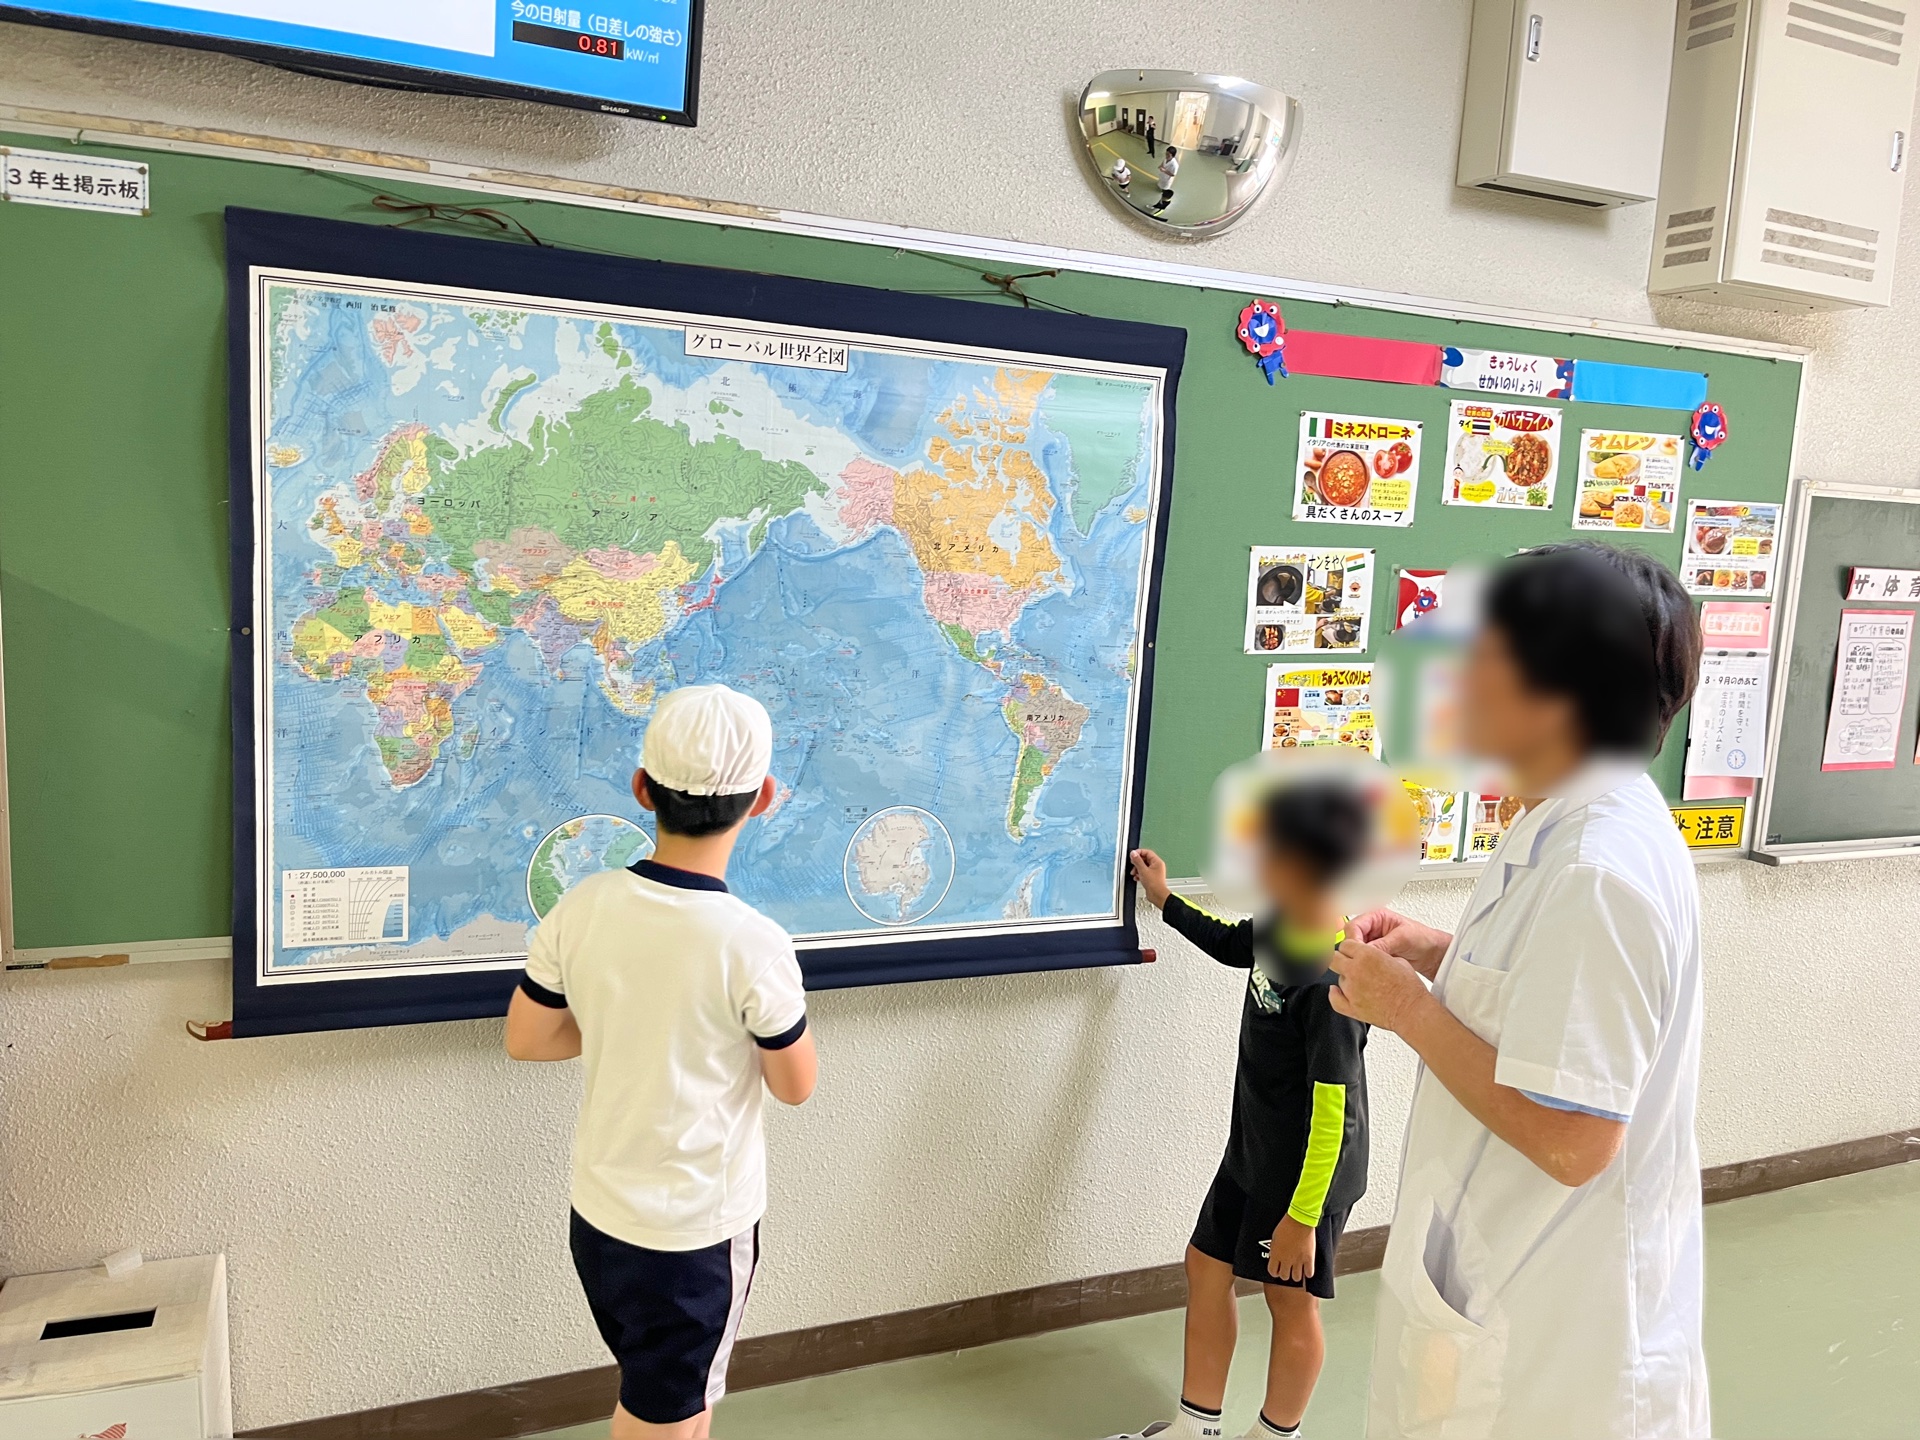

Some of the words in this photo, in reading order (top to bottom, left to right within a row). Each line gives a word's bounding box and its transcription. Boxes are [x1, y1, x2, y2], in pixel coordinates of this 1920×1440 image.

[578, 35, 618, 56] 0.81
[601, 105, 629, 114] SHARP
[8, 168, 140, 200] 3年生掲示板
[346, 301, 362, 309] 西川
[691, 333, 845, 366] グローバル世界全図
[1489, 355, 1538, 373] きゅうしょく
[1478, 374, 1542, 394] せかいのりょうり
[1333, 421, 1412, 440] ミネストローネ
[1458, 420, 1471, 428] タイ
[1589, 432, 1657, 451] オムレツ
[417, 497, 481, 509] ヨーロッパ
[591, 509, 658, 521] アジア
[1305, 506, 1404, 522] 具だくさんのスープ
[933, 541, 999, 553] 北アメリカ
[1308, 554, 1345, 571] ナンをやく
[354, 634, 421, 644] アフリカ
[1026, 713, 1065, 722] 南アメリカ
[1695, 815, 1735, 840] 注意
